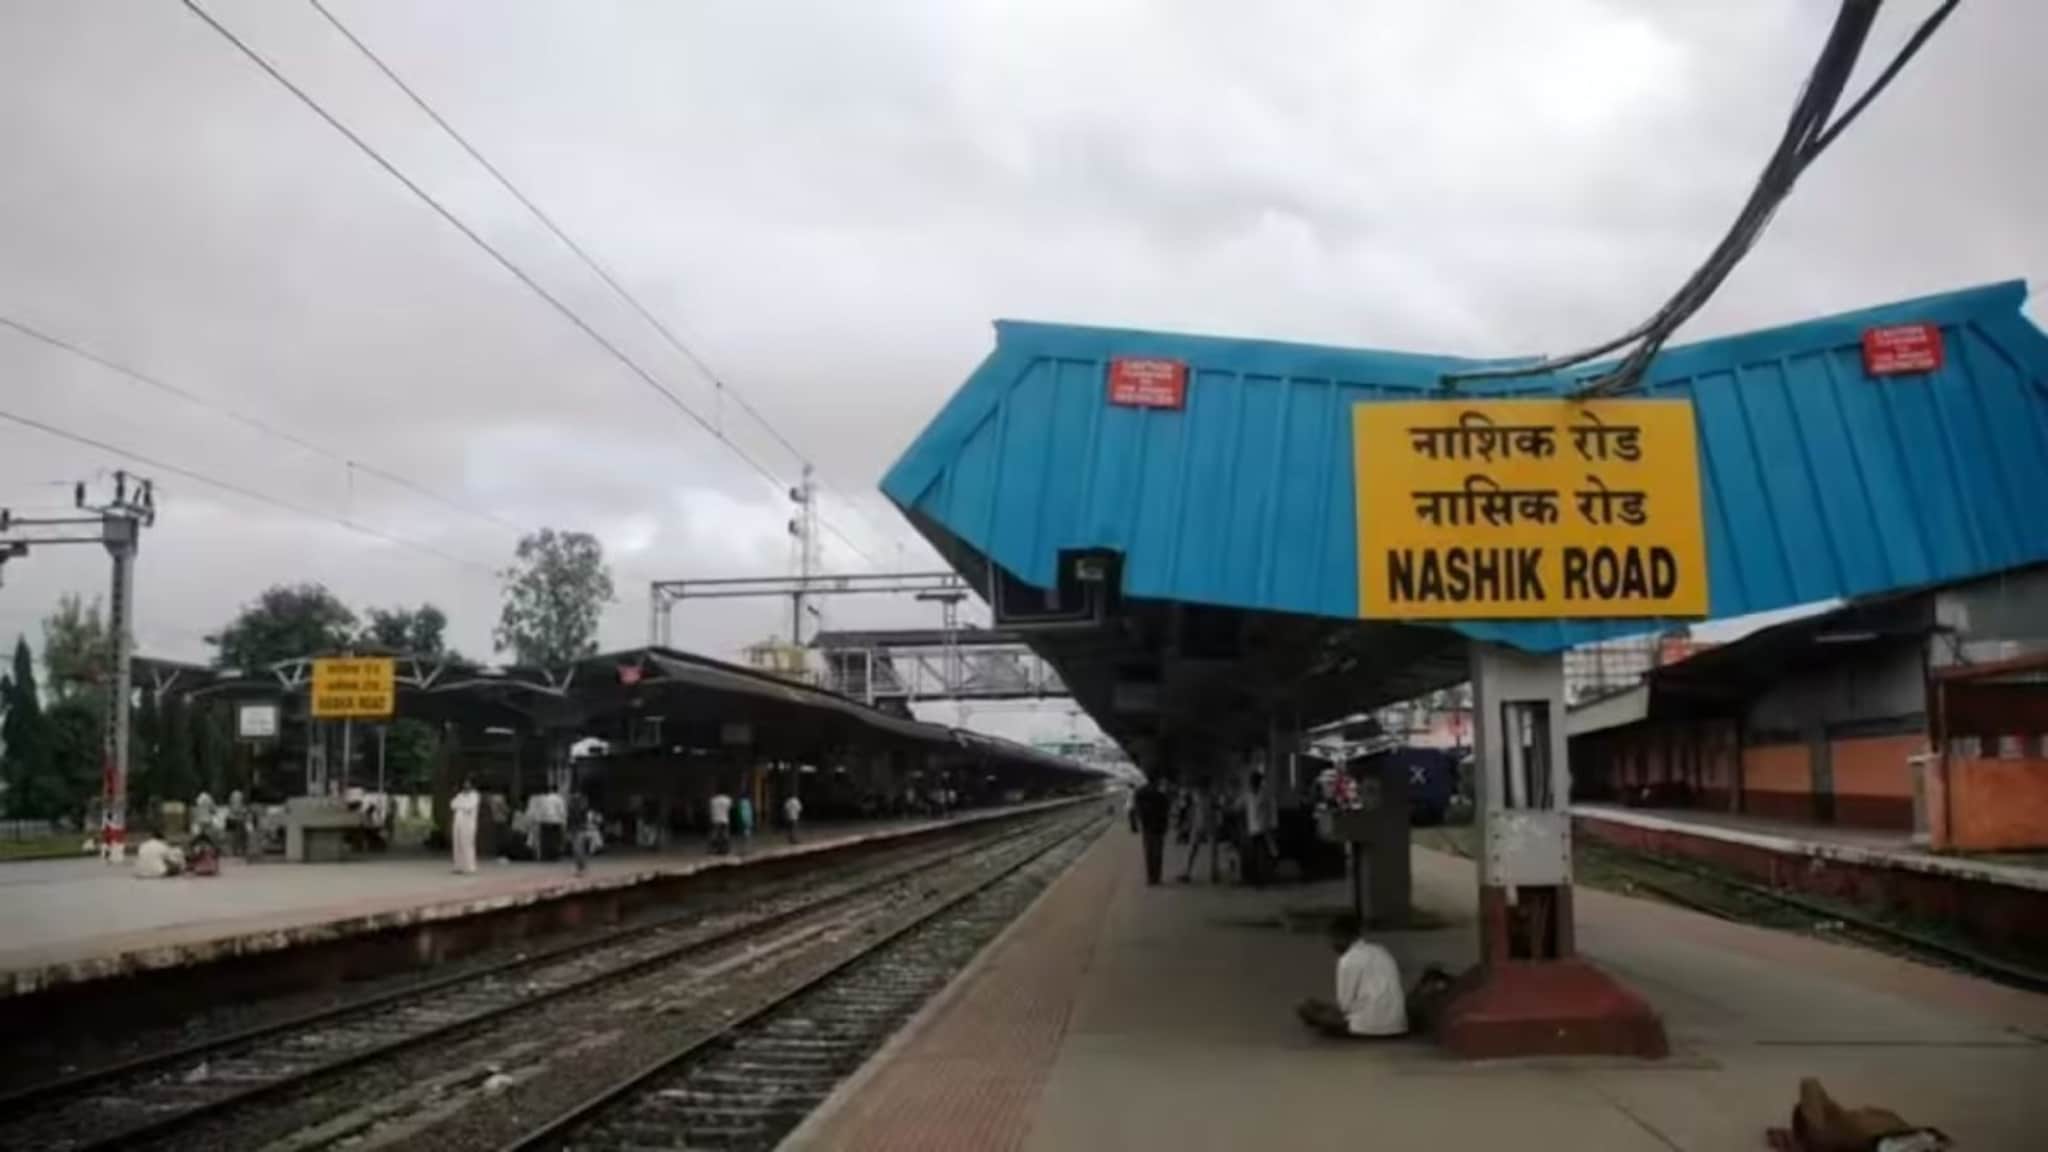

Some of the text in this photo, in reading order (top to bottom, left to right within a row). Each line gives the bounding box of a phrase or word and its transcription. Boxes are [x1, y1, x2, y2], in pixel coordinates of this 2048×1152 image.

[1409, 411, 1642, 464] नाशिक रोड
[1411, 474, 1649, 527] नासिक रोड
[1387, 545, 1678, 603] NASHIK ROAD
